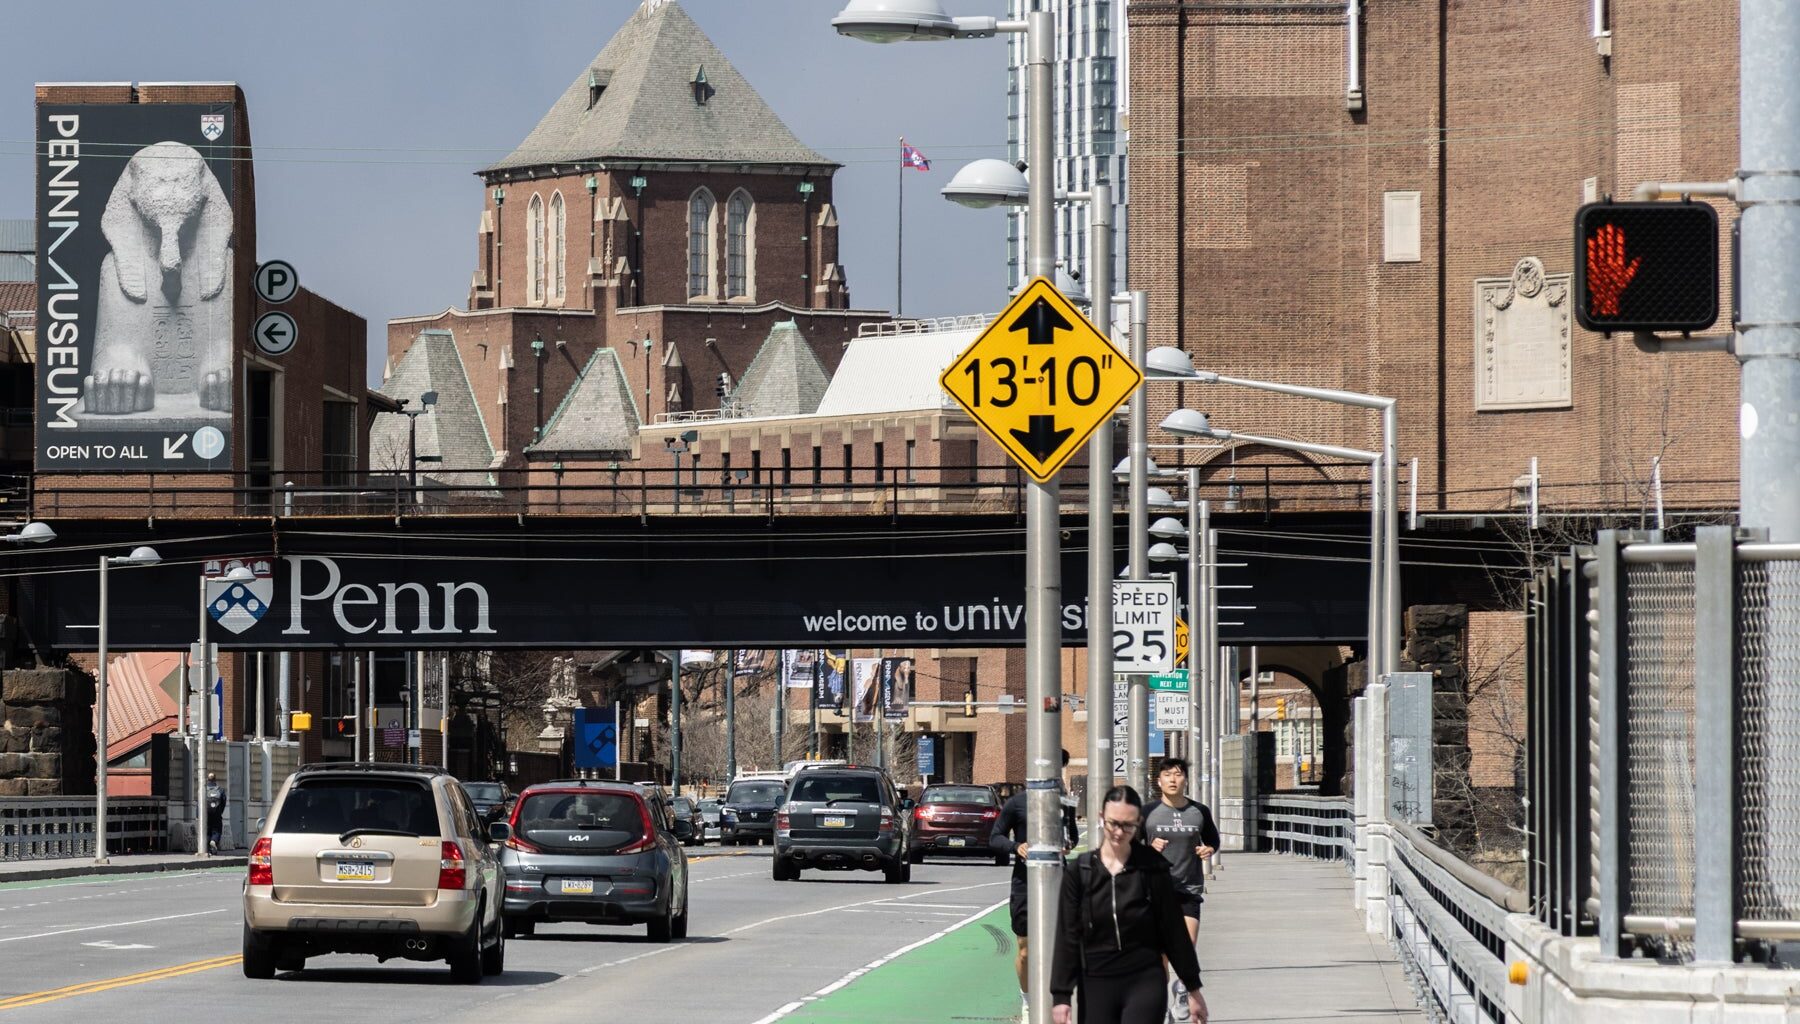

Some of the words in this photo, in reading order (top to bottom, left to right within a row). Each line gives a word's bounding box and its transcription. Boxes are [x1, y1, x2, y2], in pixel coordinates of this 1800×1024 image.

[267, 269, 288, 296] P
[46, 446, 90, 459] OPEN
[94, 446, 116, 459] TO
[119, 446, 148, 459] ALL
[281, 555, 498, 635] Penn
[1113, 592, 1169, 606] SPEED
[803, 610, 907, 632] welcome
[915, 611, 938, 632] to
[1114, 611, 1162, 625] LIMIT
[1113, 630, 1167, 662] 25
[1164, 706, 1185, 715] MUST
